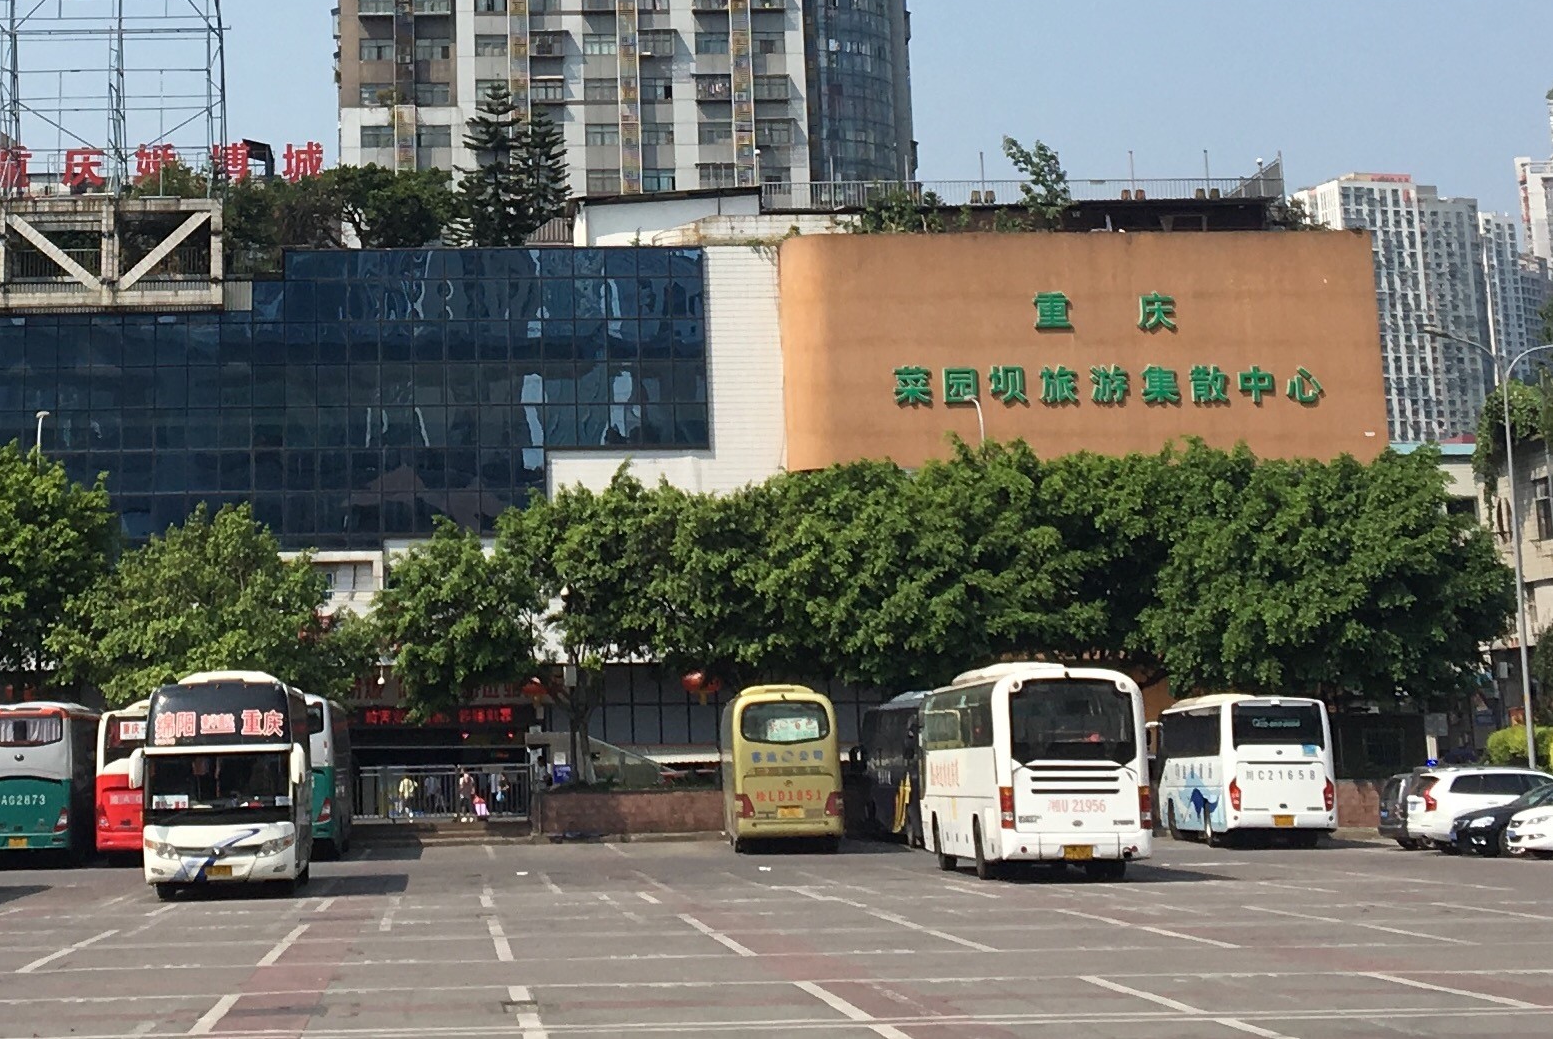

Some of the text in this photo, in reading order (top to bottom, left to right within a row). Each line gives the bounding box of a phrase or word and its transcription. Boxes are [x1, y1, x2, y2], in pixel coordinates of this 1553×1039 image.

[1033, 290, 1178, 333] 重庆
[893, 363, 1325, 407] 菜园坝旅游集散中心
[122, 722, 140, 735] 重庆
[154, 711, 197, 738] 绵阳
[241, 709, 284, 737] 重庆
